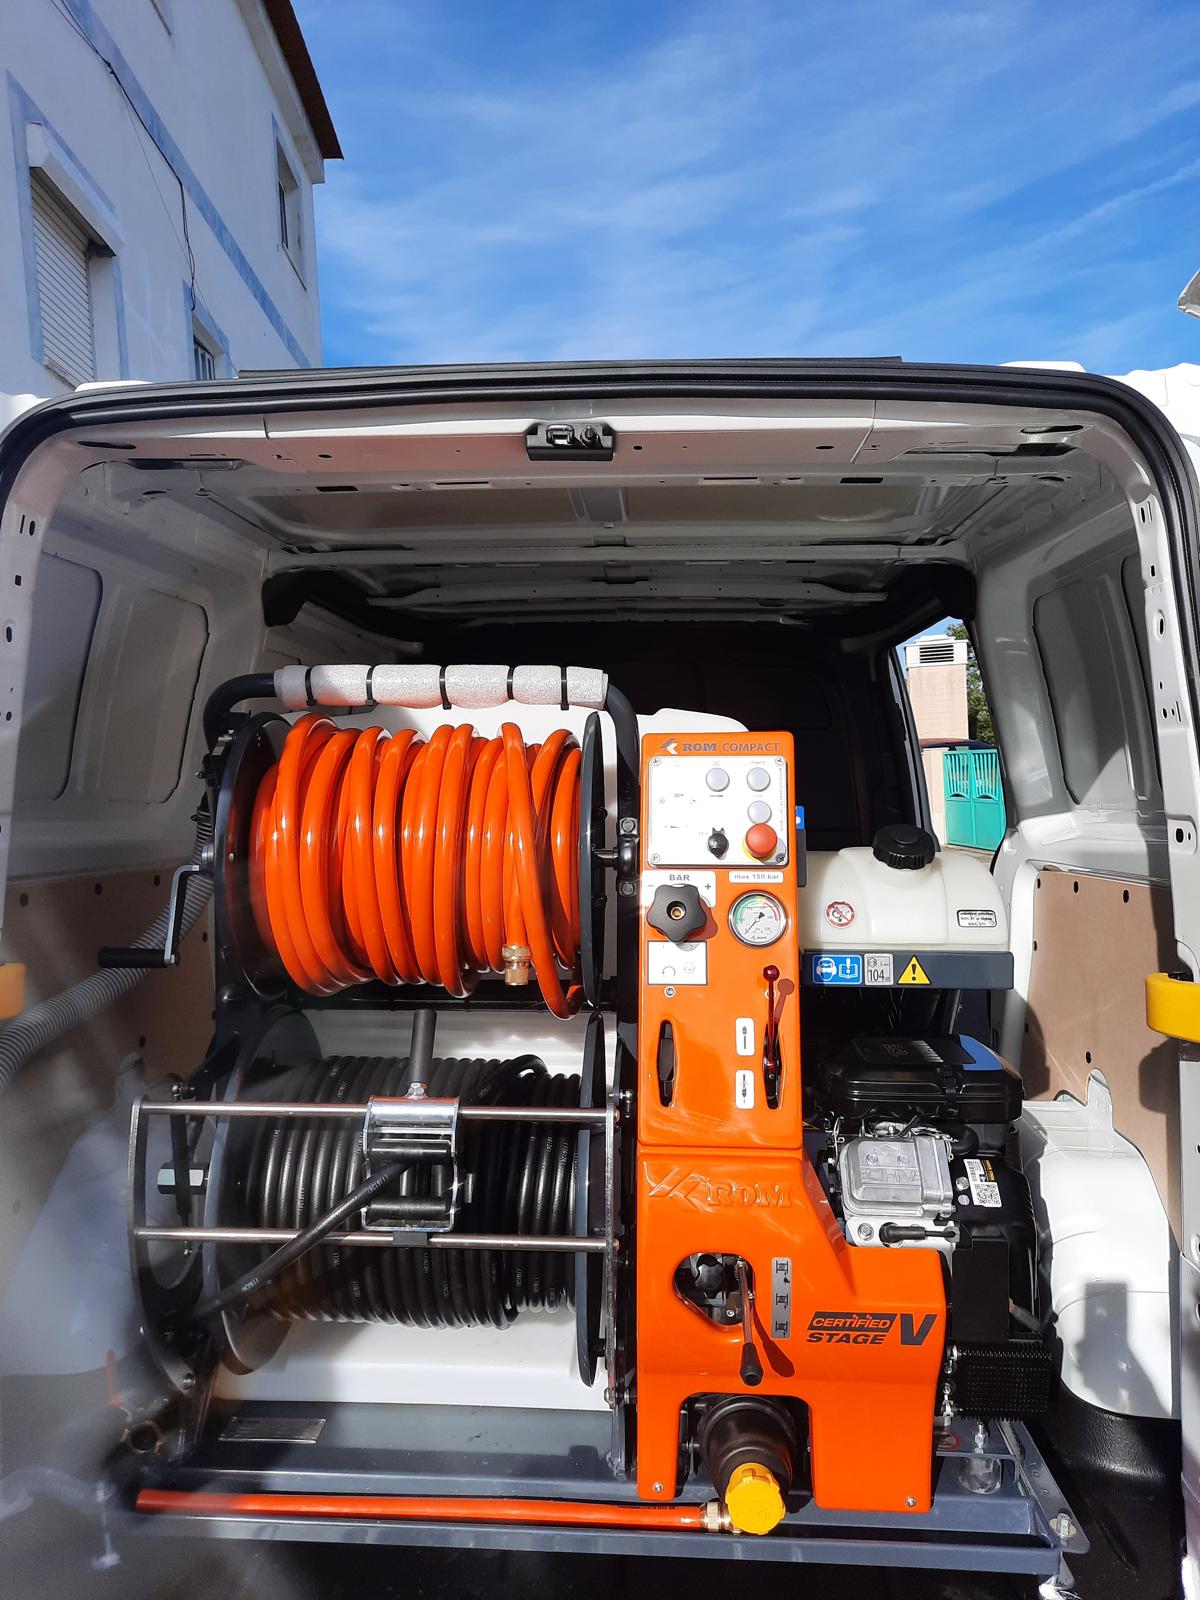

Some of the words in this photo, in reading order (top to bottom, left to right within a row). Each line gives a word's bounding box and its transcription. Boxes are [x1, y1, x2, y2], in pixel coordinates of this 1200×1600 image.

[682, 743, 717, 752] ROM
[721, 742, 781, 752] COMPACT
[669, 873, 690, 882] BAR
[868, 969, 885, 982] 104
[899, 1313, 938, 1346] V
[806, 1332, 886, 1345] STAGE
